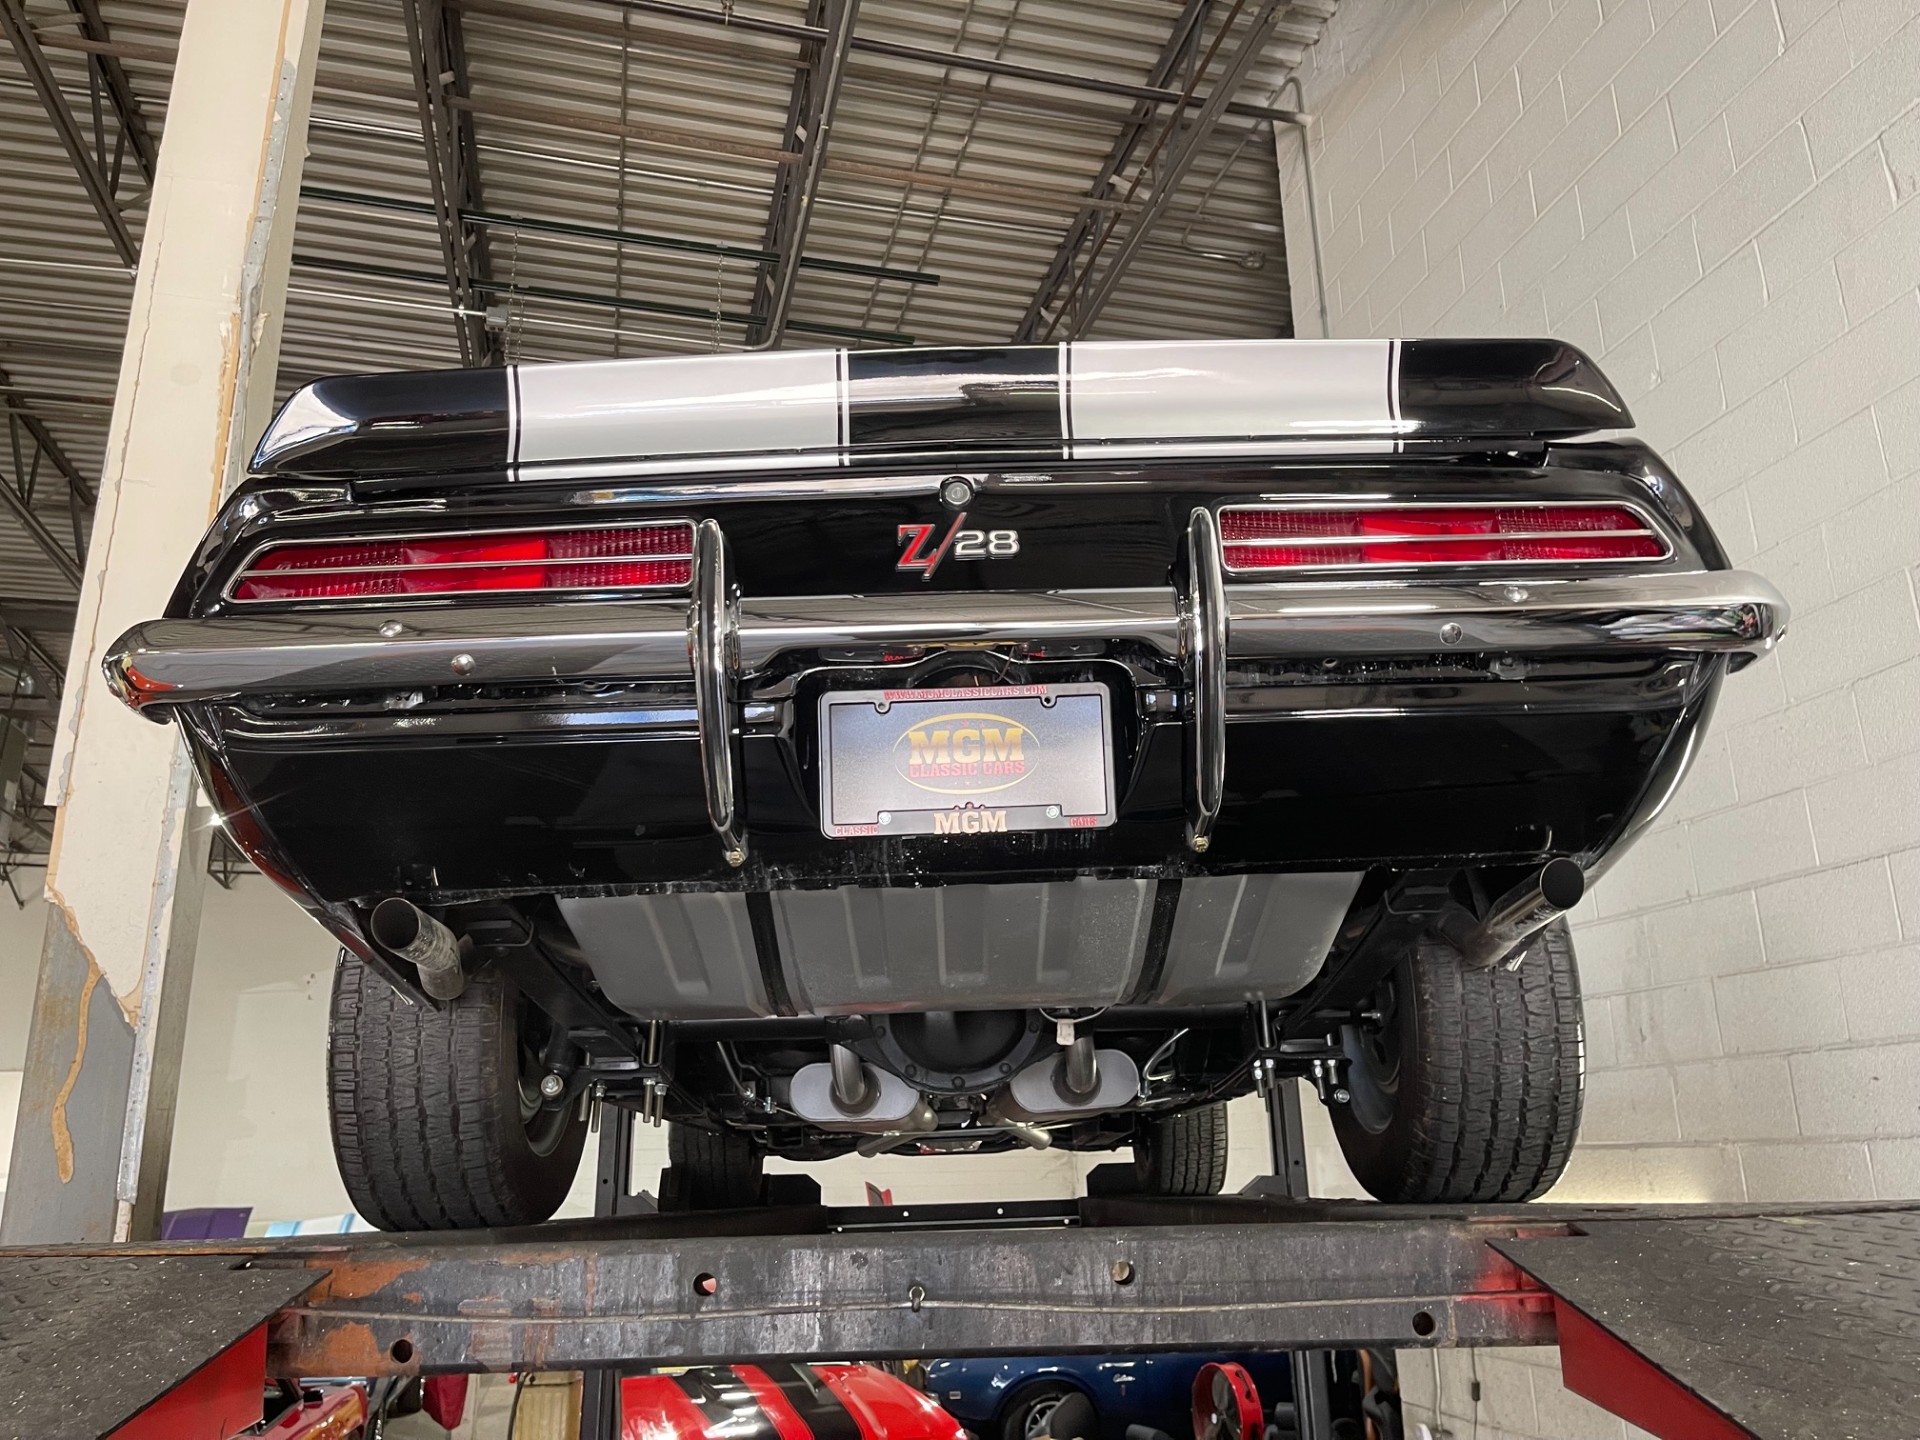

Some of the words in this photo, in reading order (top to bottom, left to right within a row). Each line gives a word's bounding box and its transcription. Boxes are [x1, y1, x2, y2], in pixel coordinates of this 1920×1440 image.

[908, 727, 1025, 765] MGM
[909, 763, 977, 778] CLASSIC
[983, 760, 1026, 774] CARS
[834, 825, 880, 836] CLASSIC
[1069, 816, 1097, 827] CARS
[933, 811, 1008, 835] MGM
